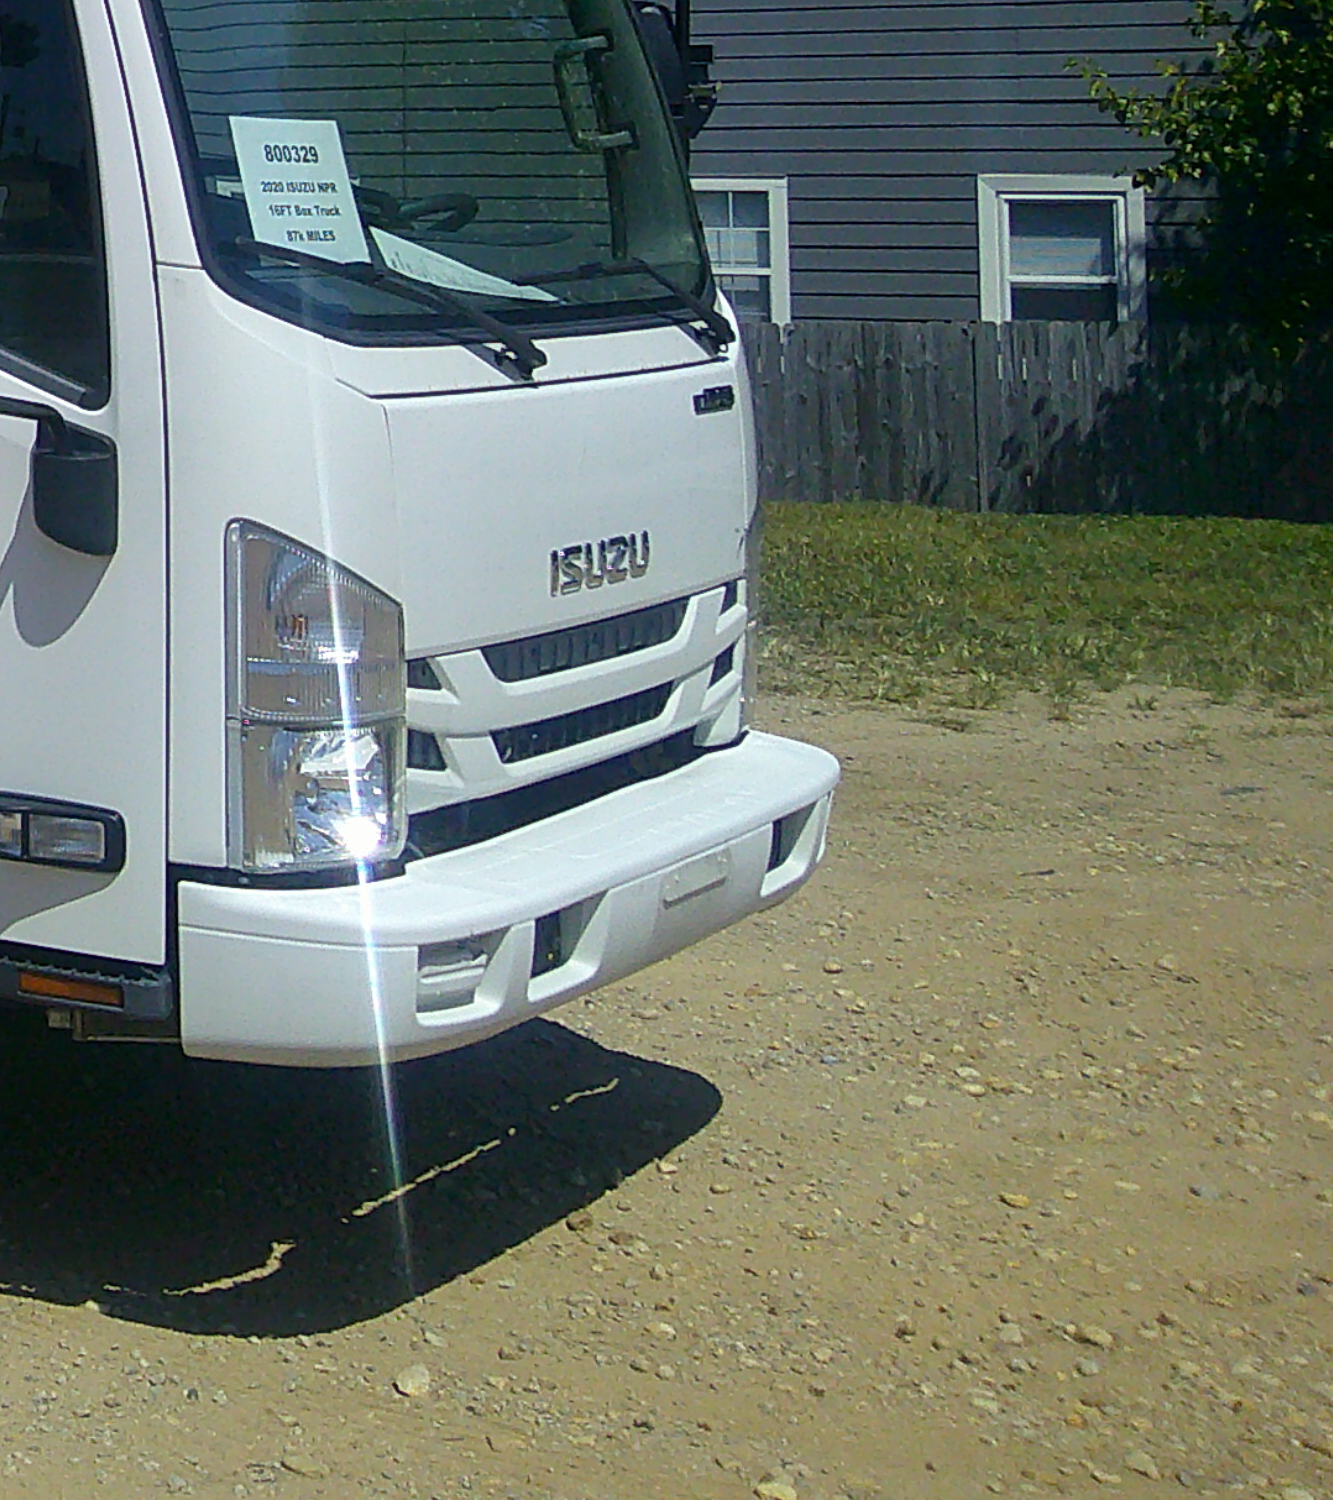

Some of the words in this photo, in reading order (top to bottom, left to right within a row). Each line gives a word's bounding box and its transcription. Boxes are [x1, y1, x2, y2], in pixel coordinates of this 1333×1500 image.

[263, 144, 319, 164] 800329
[261, 181, 284, 193] 2020
[286, 181, 315, 193] ISUZU
[317, 181, 338, 193] NPR
[269, 205, 291, 216] 16FT
[294, 205, 312, 216] Box
[314, 205, 341, 216] Truck
[306, 230, 336, 242] MILES
[550, 530, 650, 597] ISUZU
